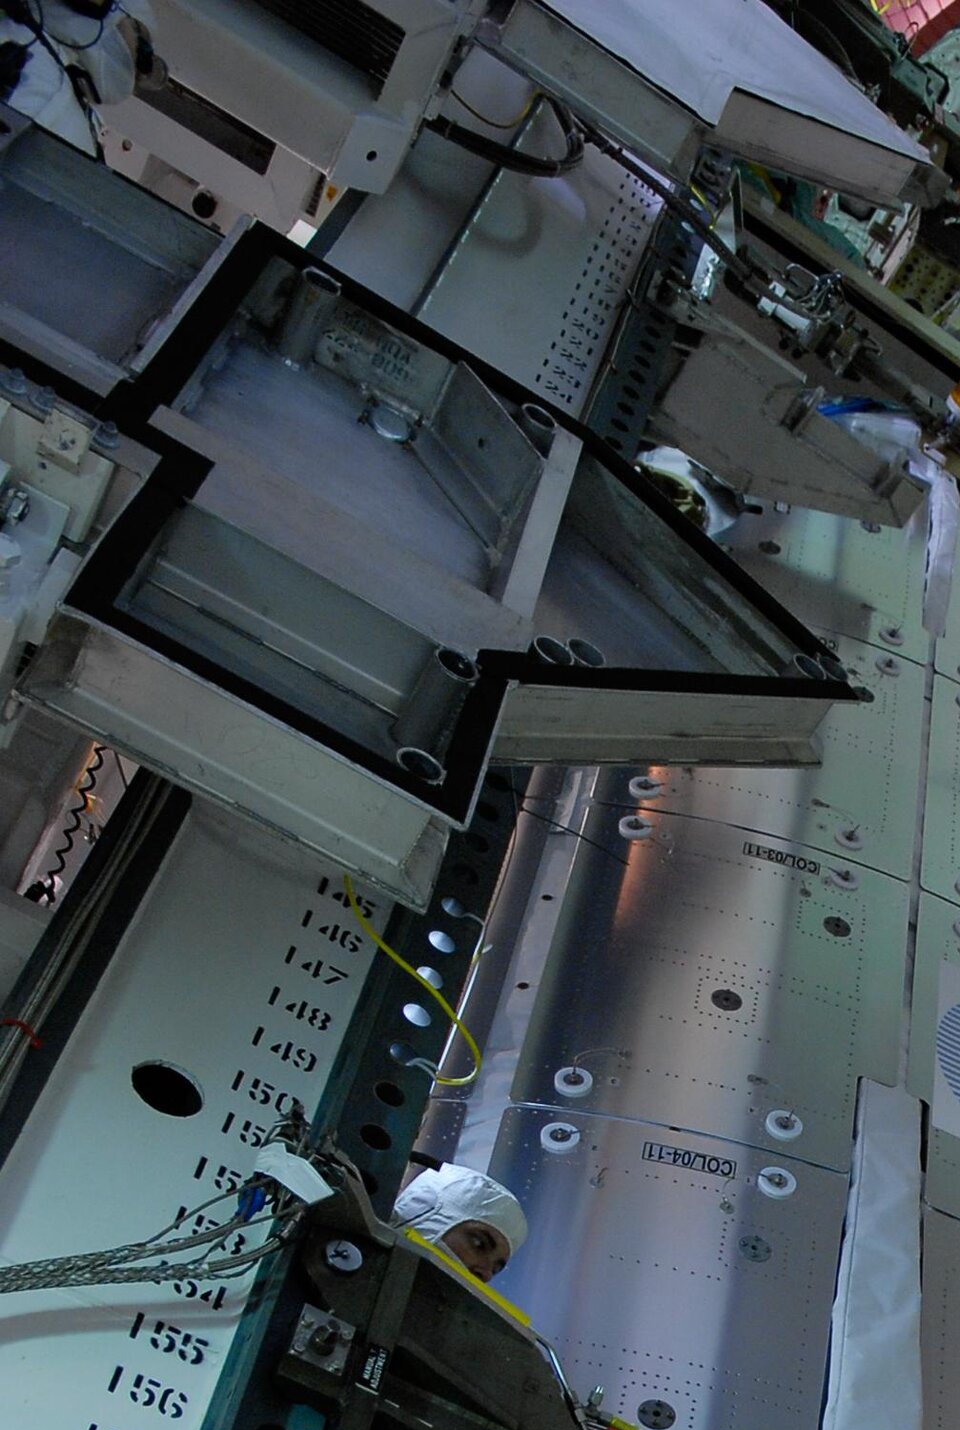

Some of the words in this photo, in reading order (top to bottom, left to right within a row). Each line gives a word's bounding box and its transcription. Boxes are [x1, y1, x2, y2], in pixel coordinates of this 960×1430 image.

[317, 876, 376, 918] 145
[301, 909, 363, 953] 146
[284, 945, 349, 985] 147
[267, 985, 332, 1031] 148
[252, 1026, 317, 1072] 149
[231, 1069, 304, 1117] 150
[221, 1111, 267, 1147] 15
[193, 1155, 242, 1193] 15
[647, 1144, 733, 1176] COL/04-11
[129, 1311, 210, 1365] 155
[107, 1365, 188, 1418] 156
